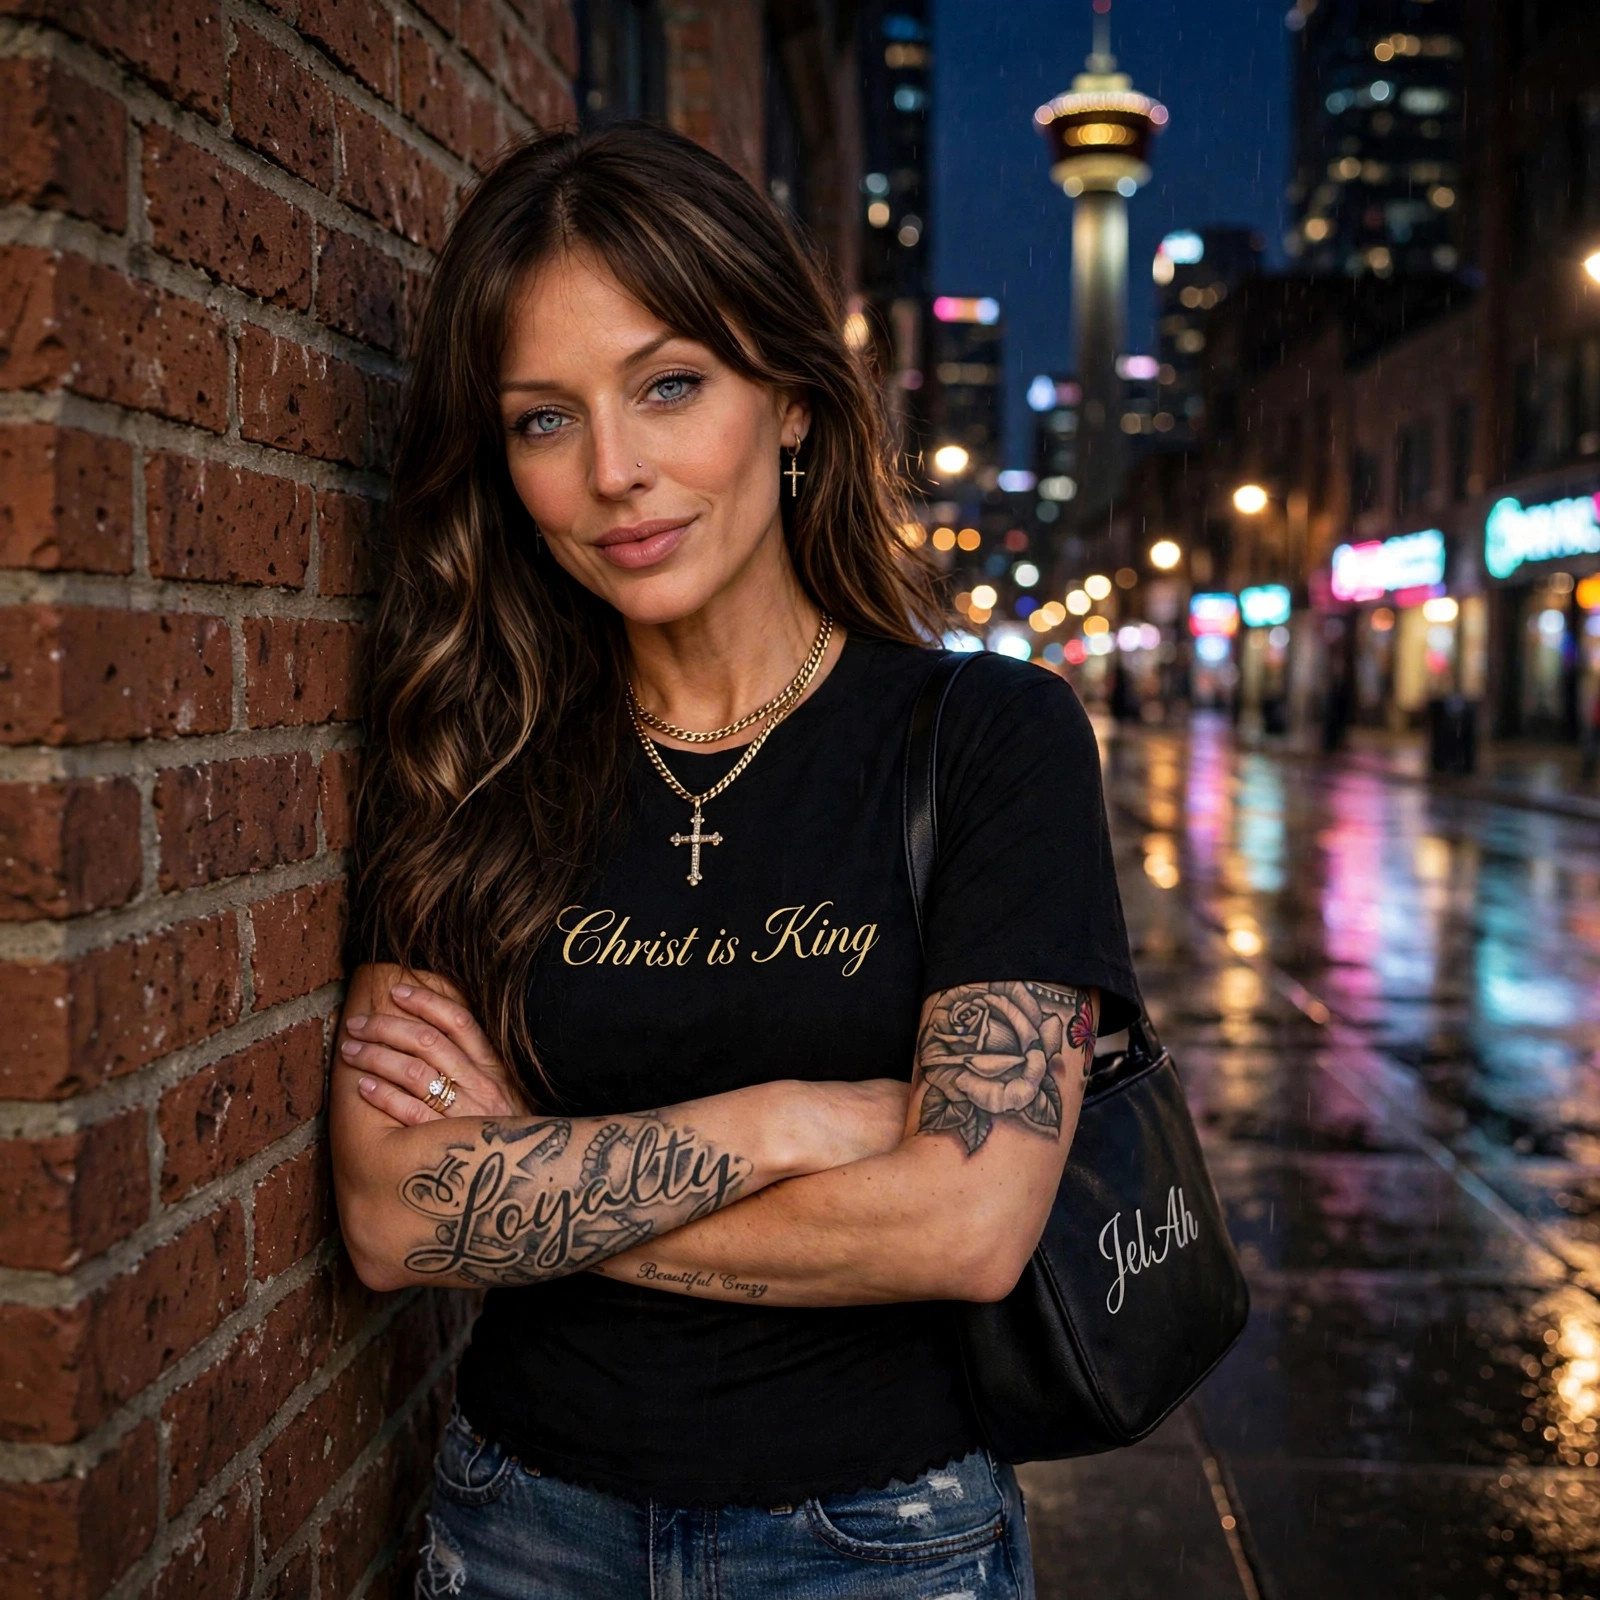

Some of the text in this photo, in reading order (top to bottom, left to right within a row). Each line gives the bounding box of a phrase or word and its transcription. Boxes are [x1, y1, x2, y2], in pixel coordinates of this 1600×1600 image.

[556, 900, 881, 977] Christ is King
[402, 1125, 740, 1273] Loyalty
[636, 1261, 769, 1298] Beautiful Crazy
